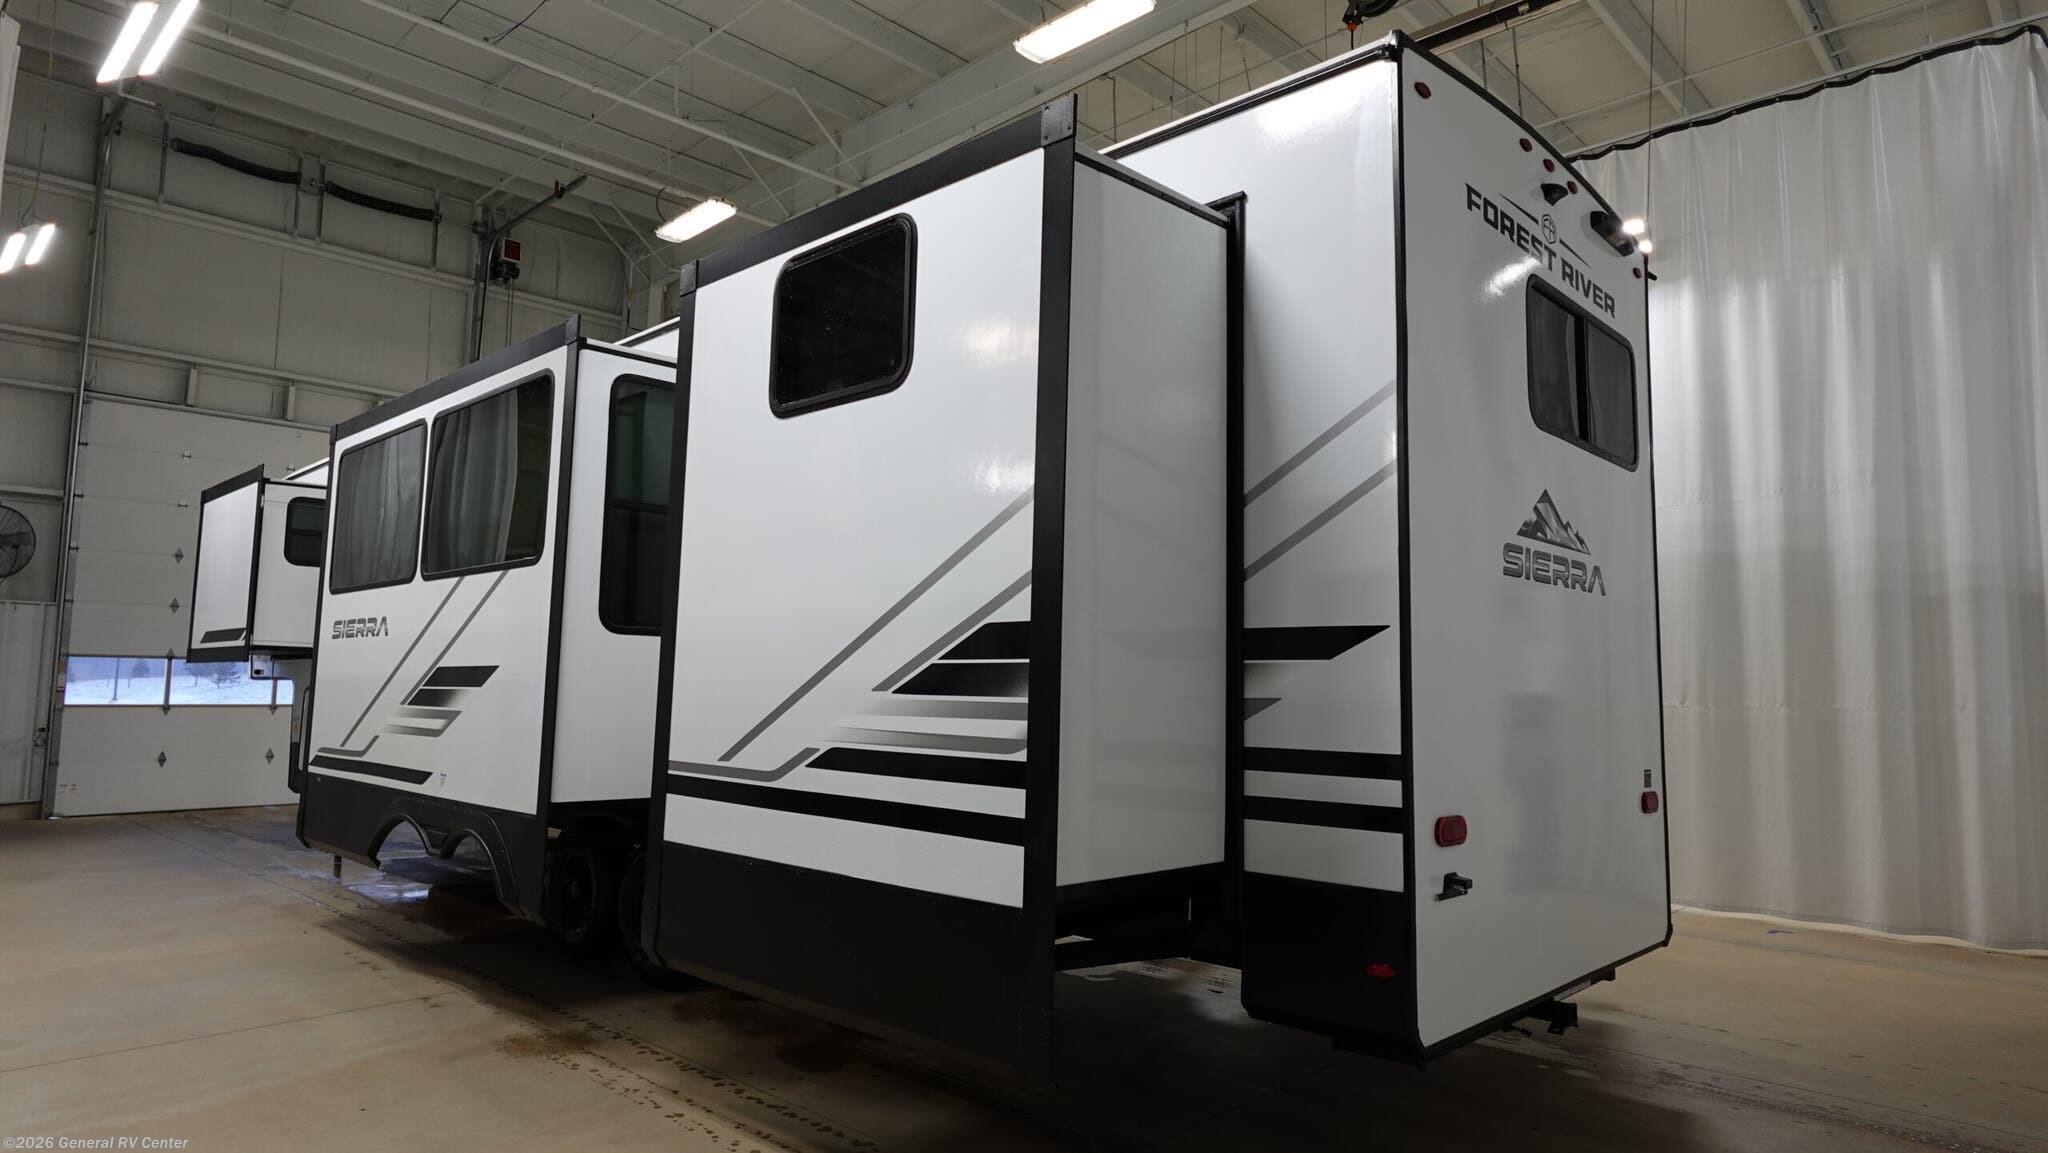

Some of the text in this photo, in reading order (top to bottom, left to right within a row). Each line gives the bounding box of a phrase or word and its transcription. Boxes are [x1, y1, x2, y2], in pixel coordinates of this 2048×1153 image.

[1465, 182, 1616, 319] FOREST RIVER
[1503, 542, 1606, 596] SIERRA
[331, 616, 389, 639] SIERRA
